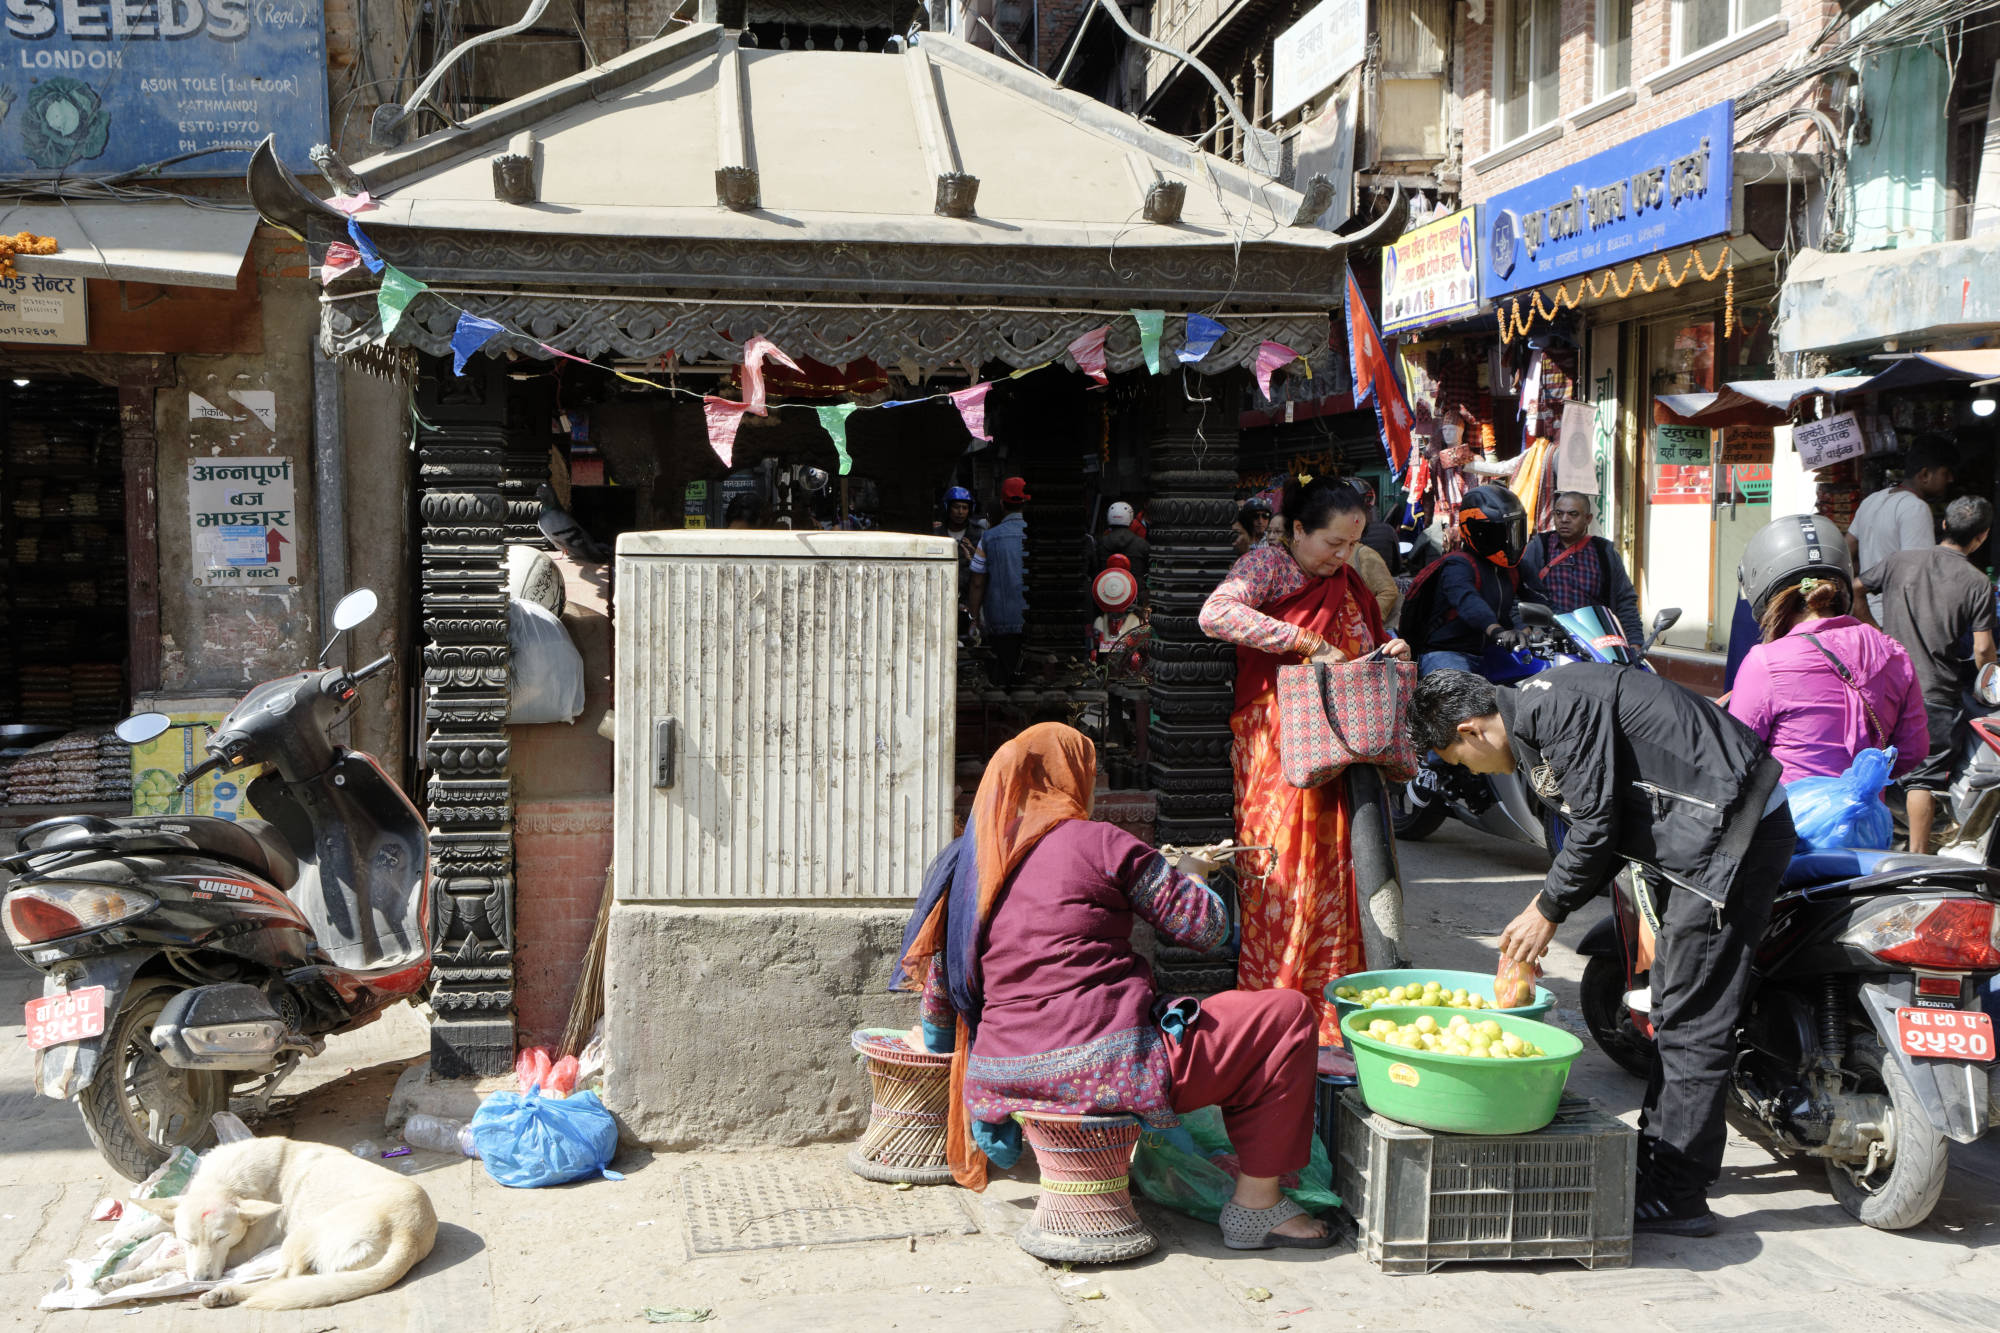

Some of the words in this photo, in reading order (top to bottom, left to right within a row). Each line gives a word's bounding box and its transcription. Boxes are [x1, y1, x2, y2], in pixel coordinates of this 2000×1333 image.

[5, 0, 250, 38] SEEDS
[21, 49, 123, 69] LONDON
[140, 78, 177, 92] ASON
[181, 78, 217, 91] TOLE
[177, 99, 259, 113] KATHMANDU
[178, 120, 260, 133] ESTD:1970
[178, 140, 197, 151] PH
[32, 273, 76, 294] सेन्टर
[1661, 427, 1706, 442] खुवा
[192, 461, 291, 486] अन्नपूर्ण
[196, 510, 291, 527] भण्डार
[207, 566, 242, 579] जाने
[246, 566, 280, 578] बाटो
[198, 879, 255, 900] wego
[1917, 1000, 1956, 1009] HONDA
[1963, 1015, 1977, 1029] प
[1905, 1030, 1988, 1055] २५२०
